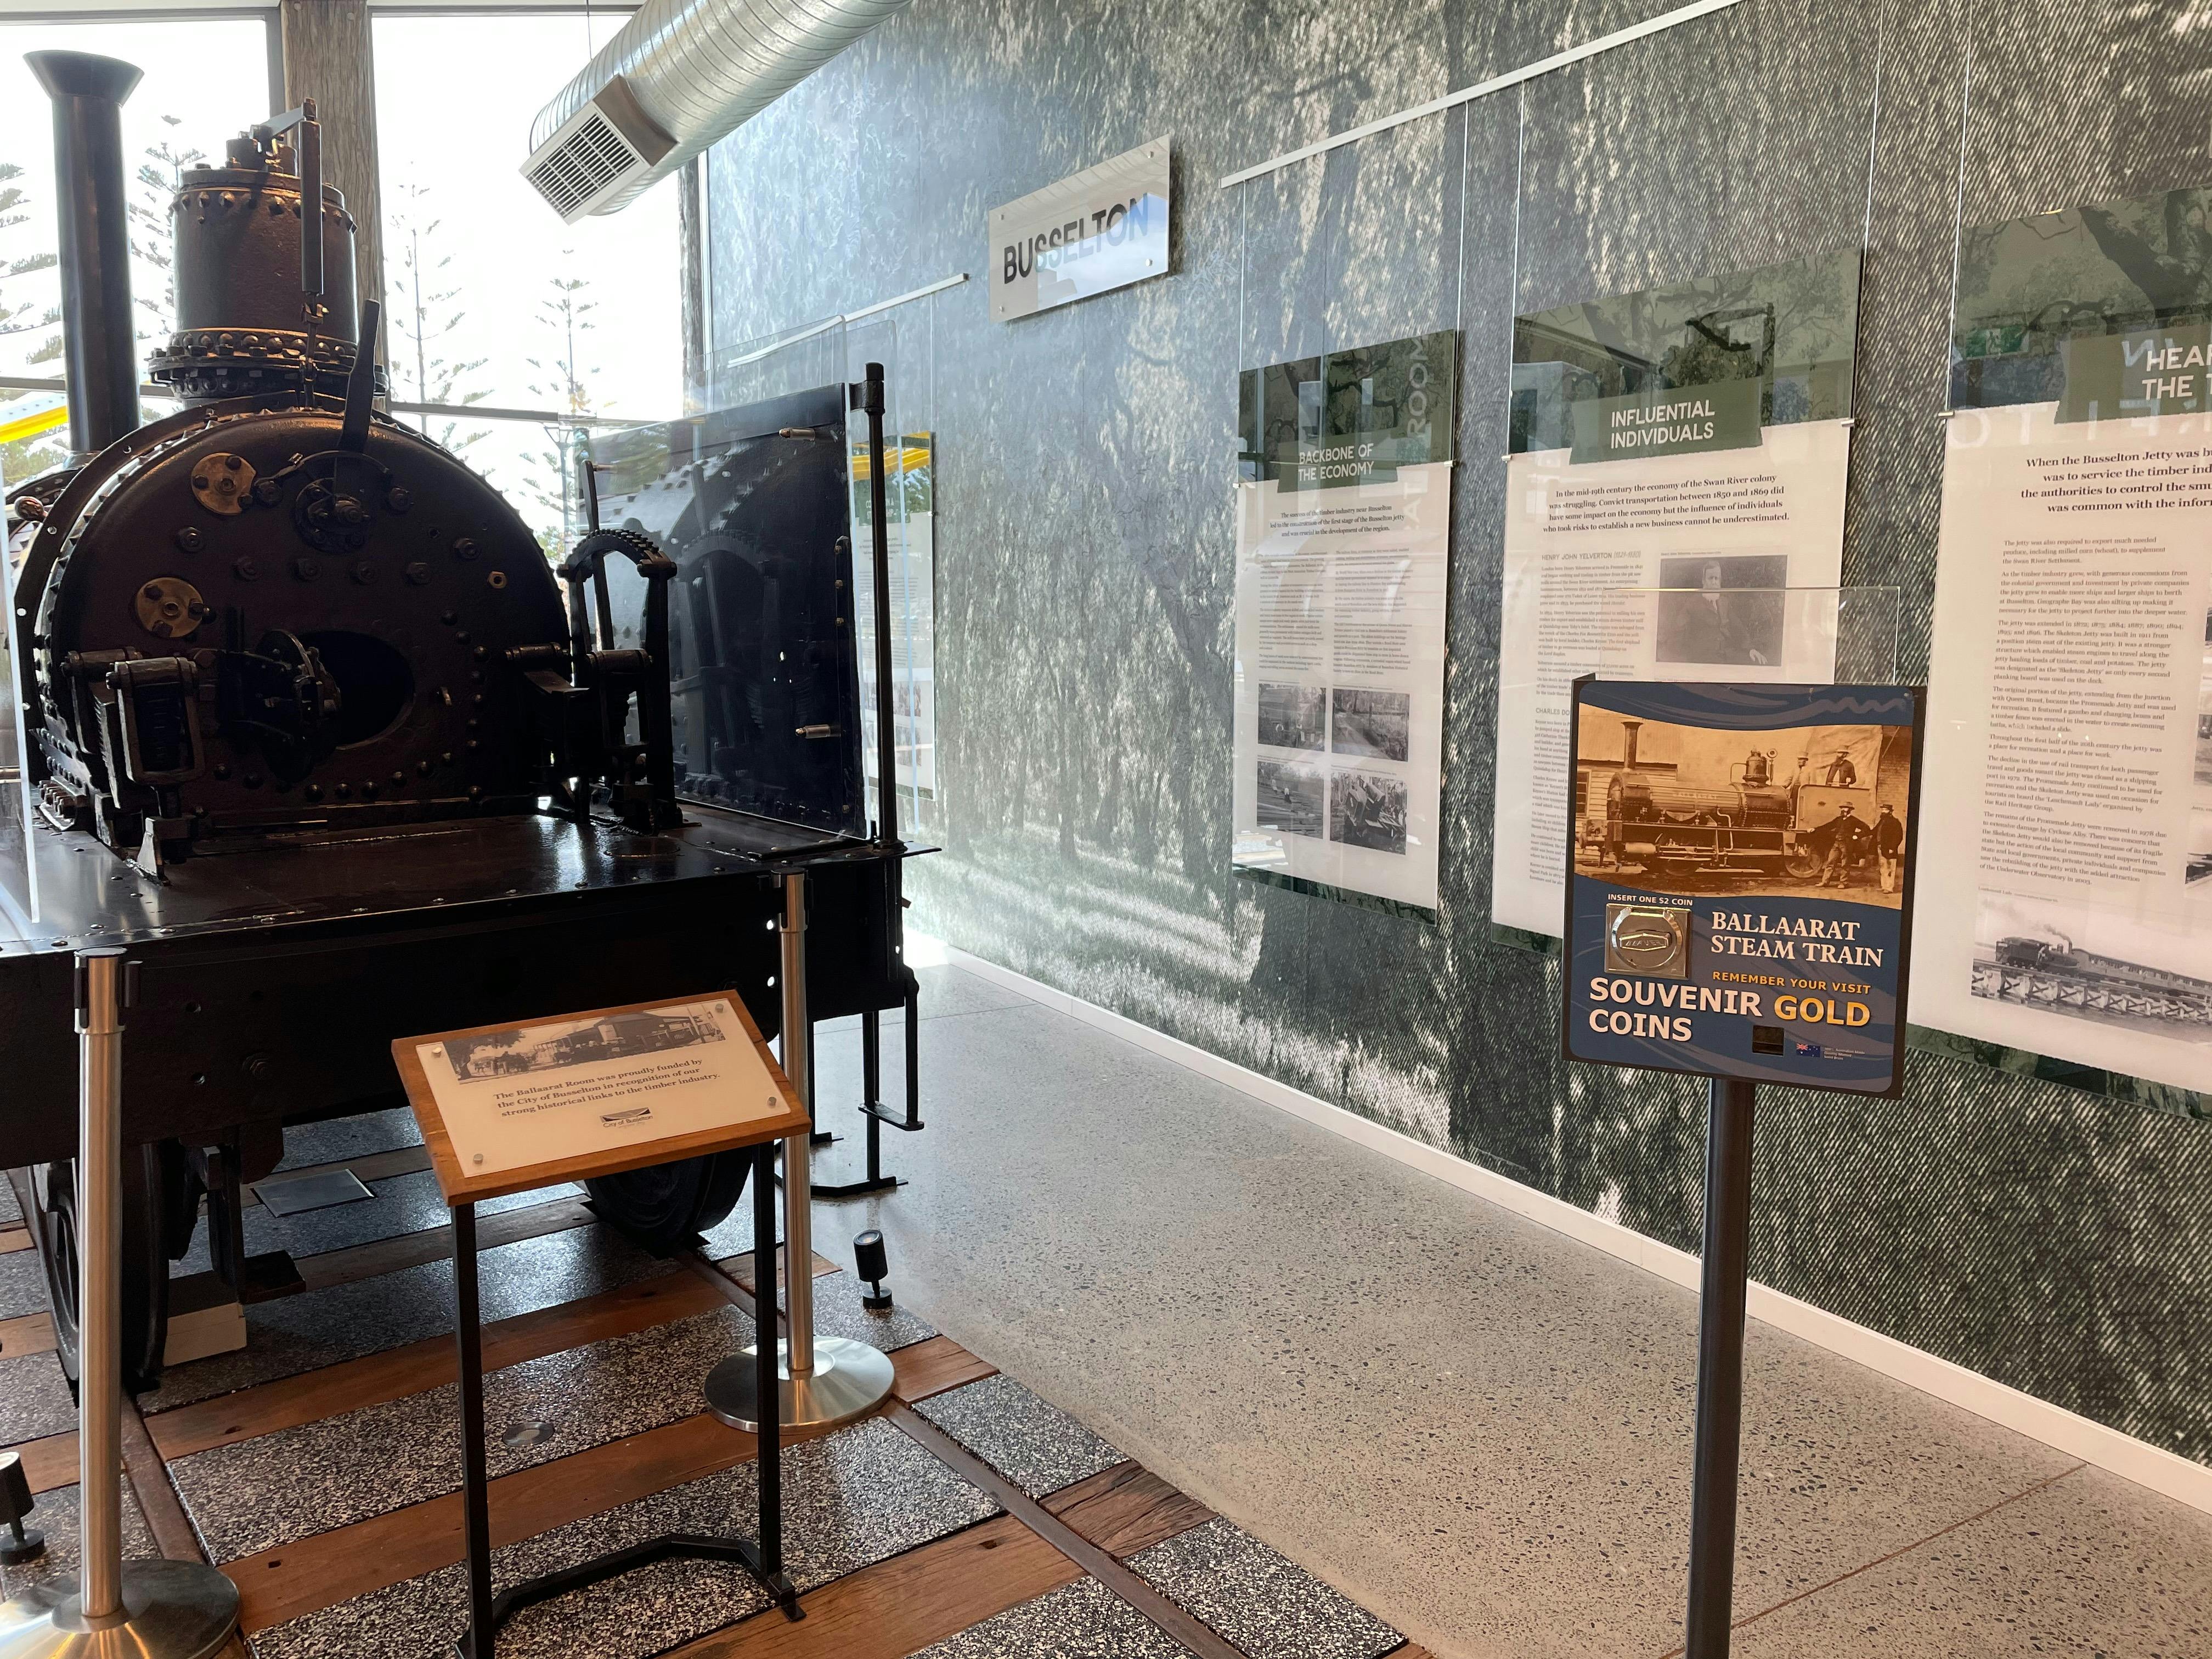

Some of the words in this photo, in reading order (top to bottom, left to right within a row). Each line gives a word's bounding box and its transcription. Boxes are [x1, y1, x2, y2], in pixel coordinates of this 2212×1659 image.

[1004, 193, 1148, 284] BUSSELTON
[2141, 375, 2194, 401] THE
[1611, 399, 1716, 428] INFLUENTIAL
[1610, 421, 1714, 449] INDIVIDUALS
[1299, 445, 1354, 465] BACKBONE
[1358, 443, 1374, 457] OF
[2026, 458, 2058, 467] When
[2062, 456, 2080, 465] the
[2083, 453, 2139, 464] Busselton
[2142, 451, 2172, 461] Jetty
[1297, 466, 1316, 481] THE
[1319, 460, 1374, 479] ECONOMY
[2081, 469, 2122, 479] service
[2125, 467, 2145, 477] the
[2147, 465, 2190, 476] timber
[1576, 487, 1605, 496] mid-19th
[1680, 479, 1689, 488] of
[1690, 479, 1702, 487] the
[1726, 476, 1748, 484] River
[1750, 474, 1776, 483] colony
[2021, 489, 2038, 498] the
[2040, 486, 2102, 496] authorities
[2119, 482, 2162, 493] control
[2166, 482, 2186, 491] the
[1562, 500, 1597, 509] struggling.
[1598, 498, 1624, 506] Convict
[1626, 494, 1678, 505] transportation
[1713, 490, 1731, 499] 1850
[1732, 488, 1748, 496] and
[1770, 486, 1784, 494] did
[2125, 499, 2152, 509] with
[2155, 498, 2175, 508] the
[1583, 511, 1606, 520] impact
[1690, 504, 1725, 512] influence
[1727, 502, 1736, 510] of
[1737, 499, 1782, 509] individuals
[1598, 521, 1628, 529] establish
[1651, 518, 1683, 527] business
[1723, 512, 1790, 523] underestimated.
[1536, 707, 1560, 715] CHARLES
[1607, 893, 1637, 902] INSERT
[1639, 895, 1657, 904] ONE
[1711, 911, 1861, 941] BALLAARAT
[1711, 934, 1796, 960] STEAM
[1805, 941, 1884, 967] TRAIN
[1713, 970, 1785, 987] REMEMBER
[1790, 978, 1827, 991] YOUR
[1832, 981, 1871, 995] VISIT
[1590, 977, 1763, 1017] SOUVENIR
[1774, 994, 1871, 1027] GOLD
[1589, 1008, 1692, 1042] COINS
[516, 1083, 563, 1096] Ballaarat
[564, 1078, 595, 1087] Room
[617, 1067, 654, 1079] proudly
[656, 1060, 690, 1071] funded
[552, 1086, 601, 1098] Busselton
[616, 1074, 670, 1087] recognition
[501, 1107, 536, 1116] strong
[536, 1096, 586, 1110] historical
[586, 1092, 613, 1101] links
[644, 1081, 676, 1090] timber
[678, 1074, 720, 1084] industry.
